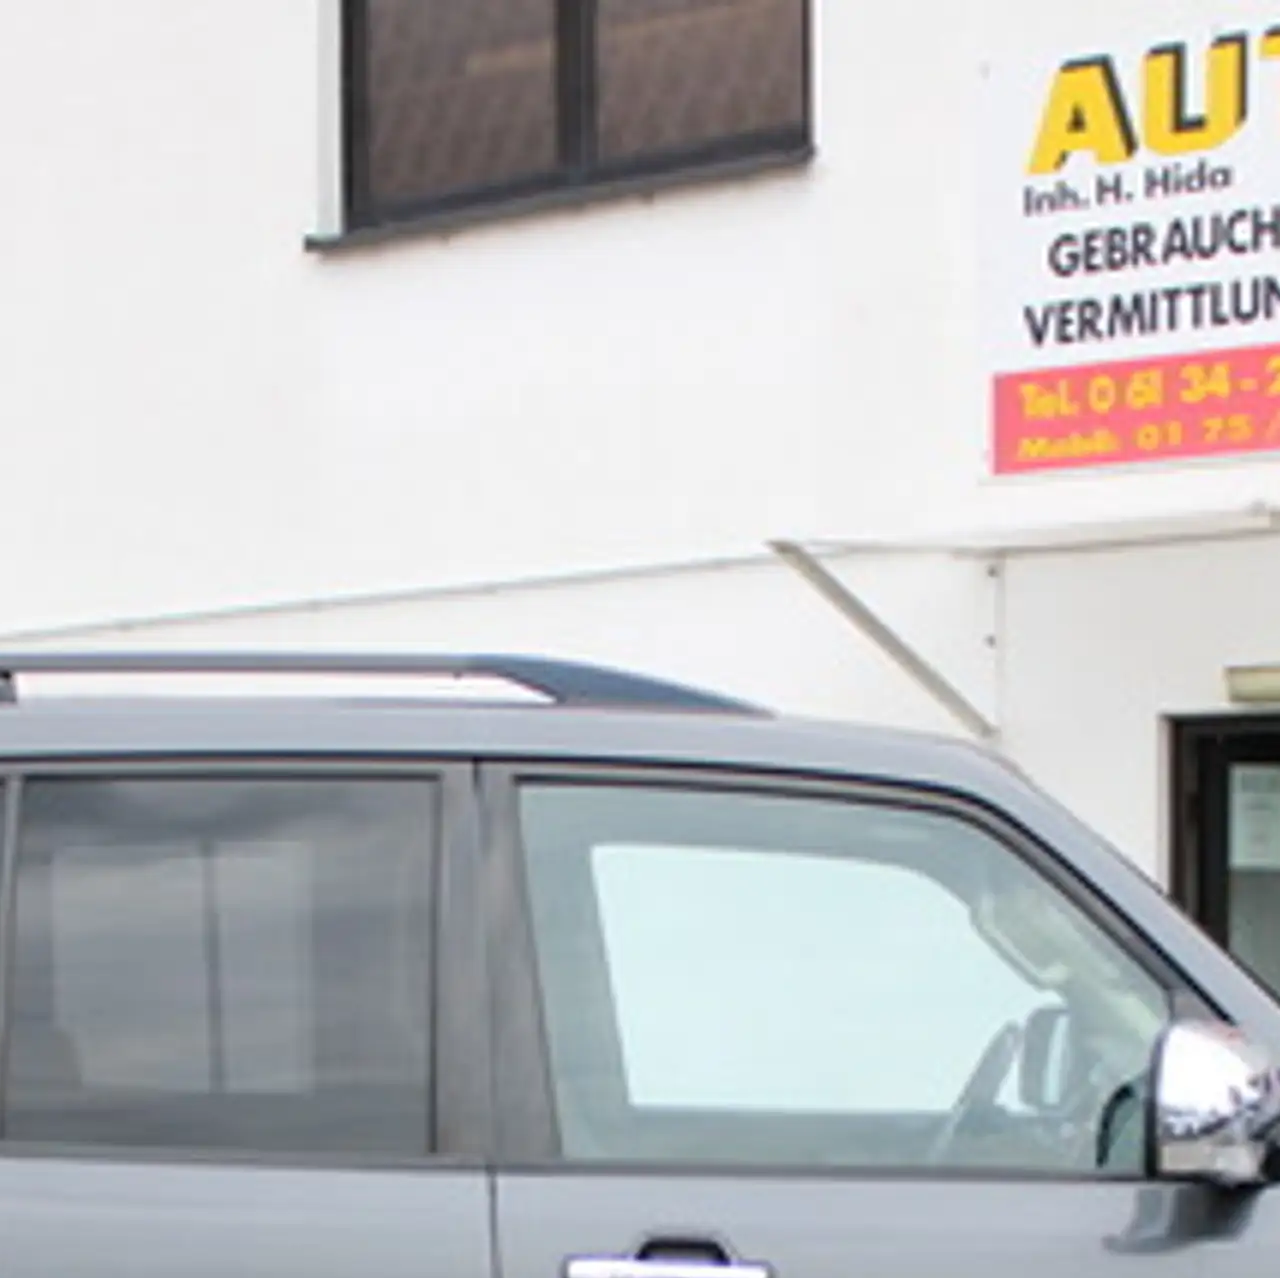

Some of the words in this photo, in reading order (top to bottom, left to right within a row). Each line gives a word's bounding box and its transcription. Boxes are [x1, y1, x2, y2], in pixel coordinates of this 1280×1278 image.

[1023, 184, 1089, 217] Inh.
[1096, 172, 1134, 205] H.
[1144, 159, 1233, 197] Hida
[1087, 374, 1116, 414] 0
[1180, 362, 1230, 403] 34
[1135, 420, 1183, 450] 01
